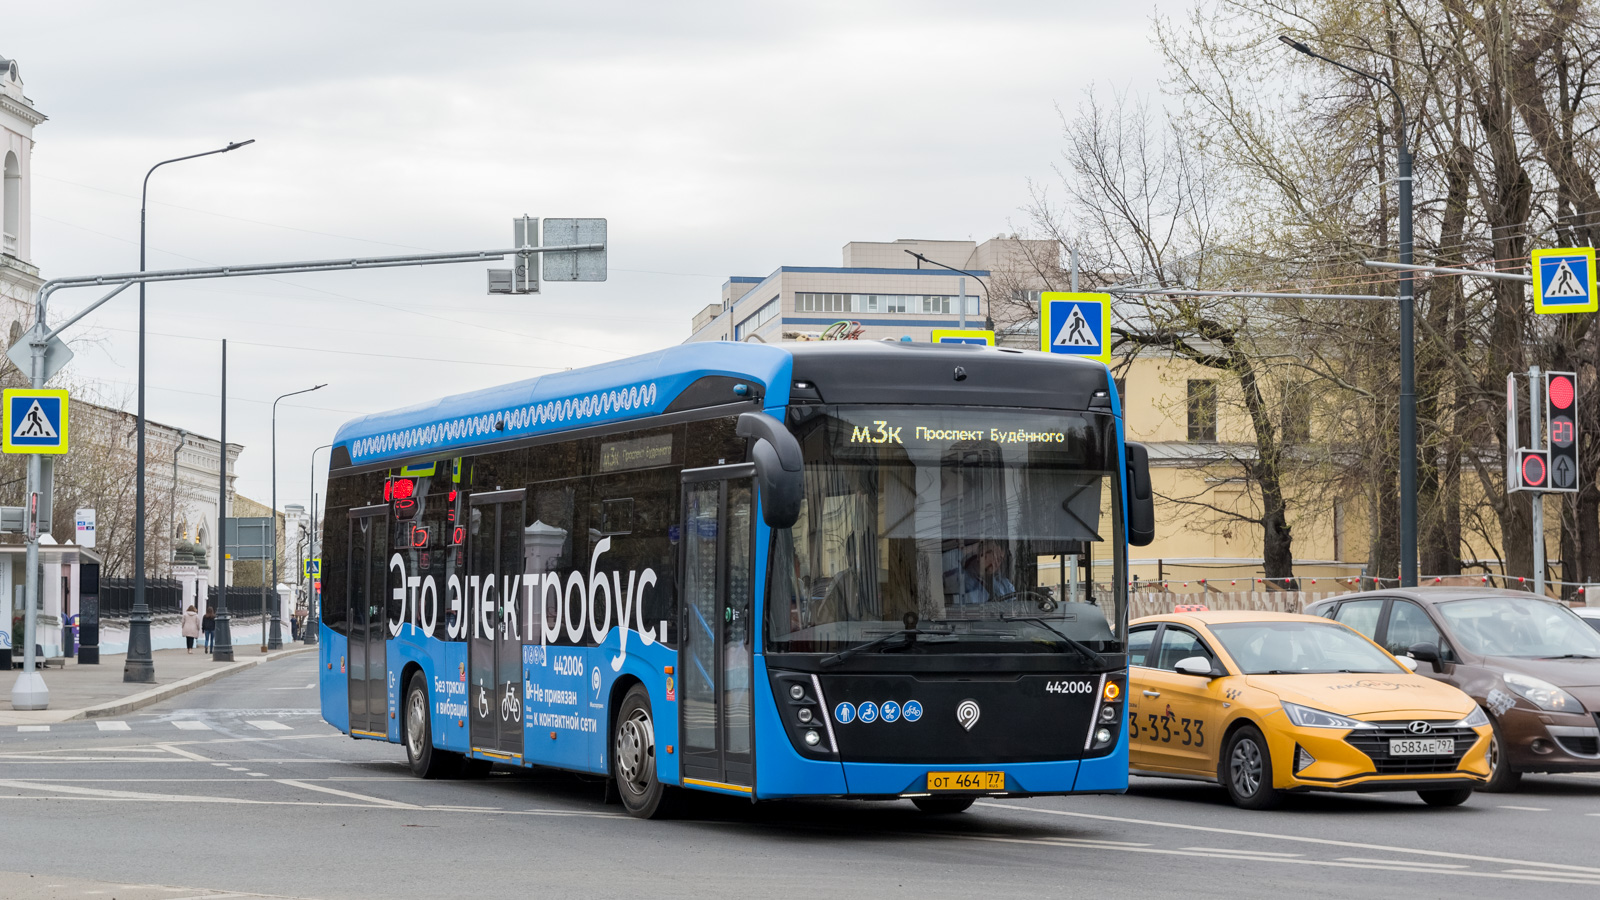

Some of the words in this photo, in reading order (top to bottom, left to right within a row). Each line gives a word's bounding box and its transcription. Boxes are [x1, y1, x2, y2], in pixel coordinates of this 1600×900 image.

[916, 426, 984, 442] Проспект
[990, 427, 1065, 444] Будённого
[1552, 421, 1573, 442] 27
[388, 552, 438, 639] Это
[448, 535, 668, 673] электробус.
[553, 655, 584, 677] 442006
[434, 675, 445, 693] Без
[446, 680, 466, 697] тряски
[533, 683, 543, 702] Не
[544, 688, 577, 707] привязан
[1045, 681, 1093, 694] 442006
[440, 698, 467, 719] вибраций
[533, 712, 539, 726] к
[539, 712, 580, 731] контактной
[580, 716, 597, 733] сети
[1436, 740, 1452, 750] 797
[933, 777, 950, 788] ОТ
[955, 774, 980, 788] 464
[987, 773, 1000, 784] 77
